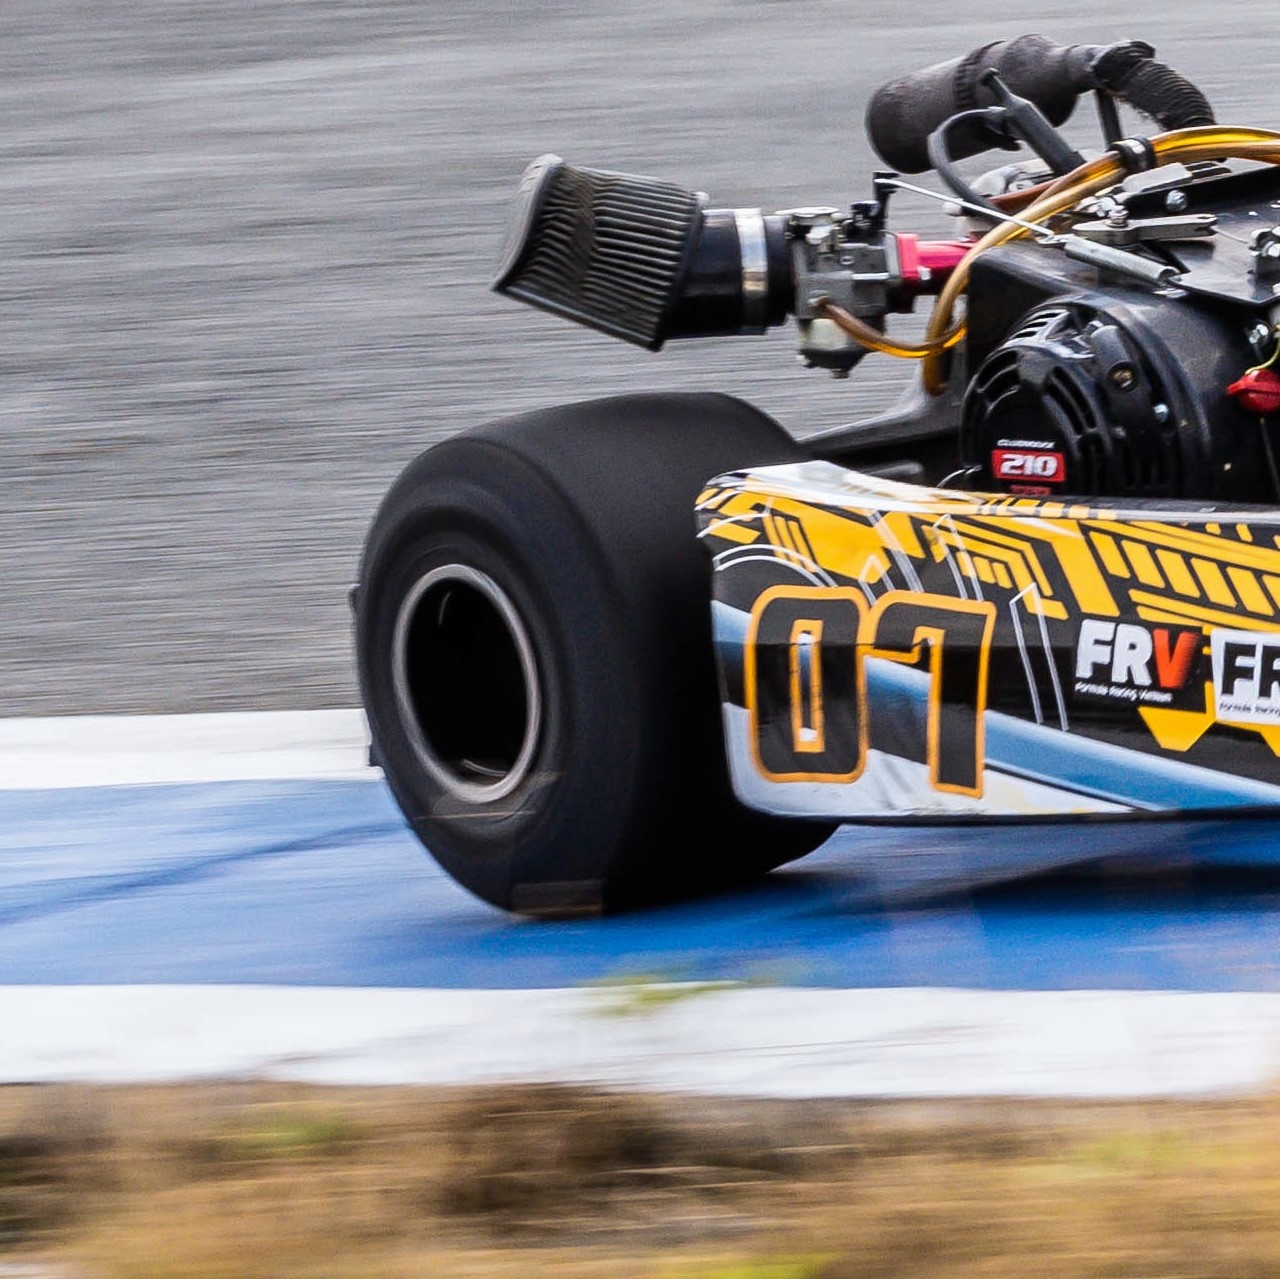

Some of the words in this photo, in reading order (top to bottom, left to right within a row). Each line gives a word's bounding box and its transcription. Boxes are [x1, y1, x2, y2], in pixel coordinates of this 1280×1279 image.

[1000, 453, 1058, 477] 210
[1075, 619, 1199, 688] FRV
[744, 584, 998, 800] 07
